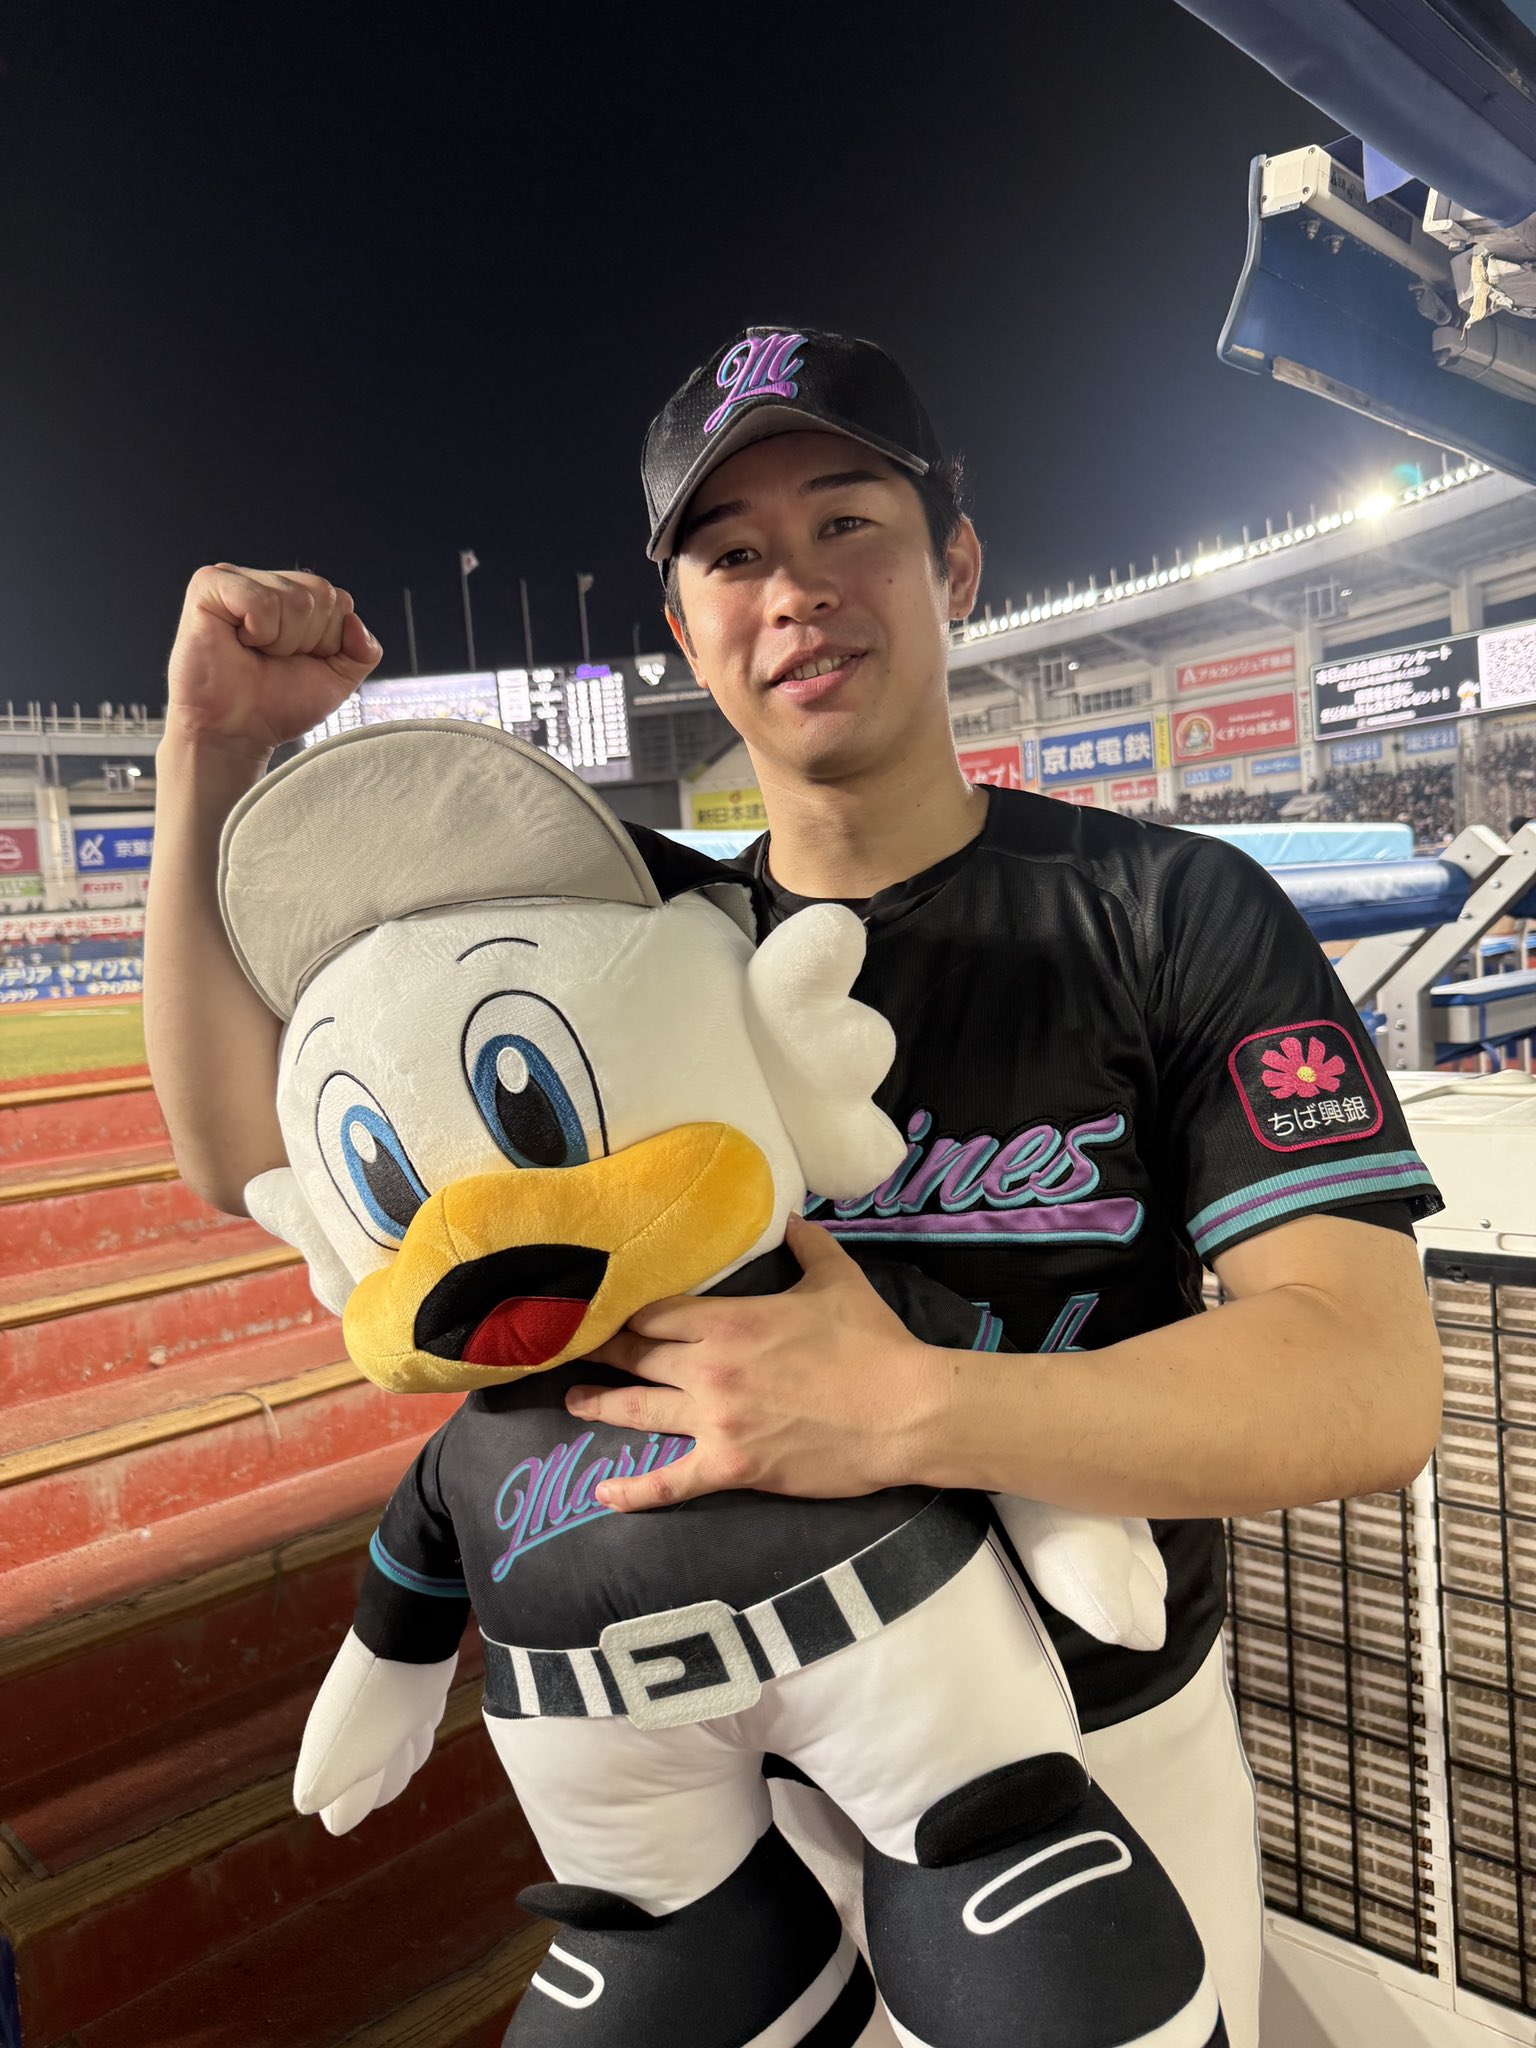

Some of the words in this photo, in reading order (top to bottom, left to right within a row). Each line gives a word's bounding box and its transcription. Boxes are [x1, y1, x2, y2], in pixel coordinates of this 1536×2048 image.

[703, 333, 809, 433] M
[1216, 717, 1292, 741] くすりの福太郎
[1041, 731, 1151, 776] 京成電鉄
[1268, 1096, 1370, 1137] ちば興銀
[803, 1108, 1146, 1243] ines
